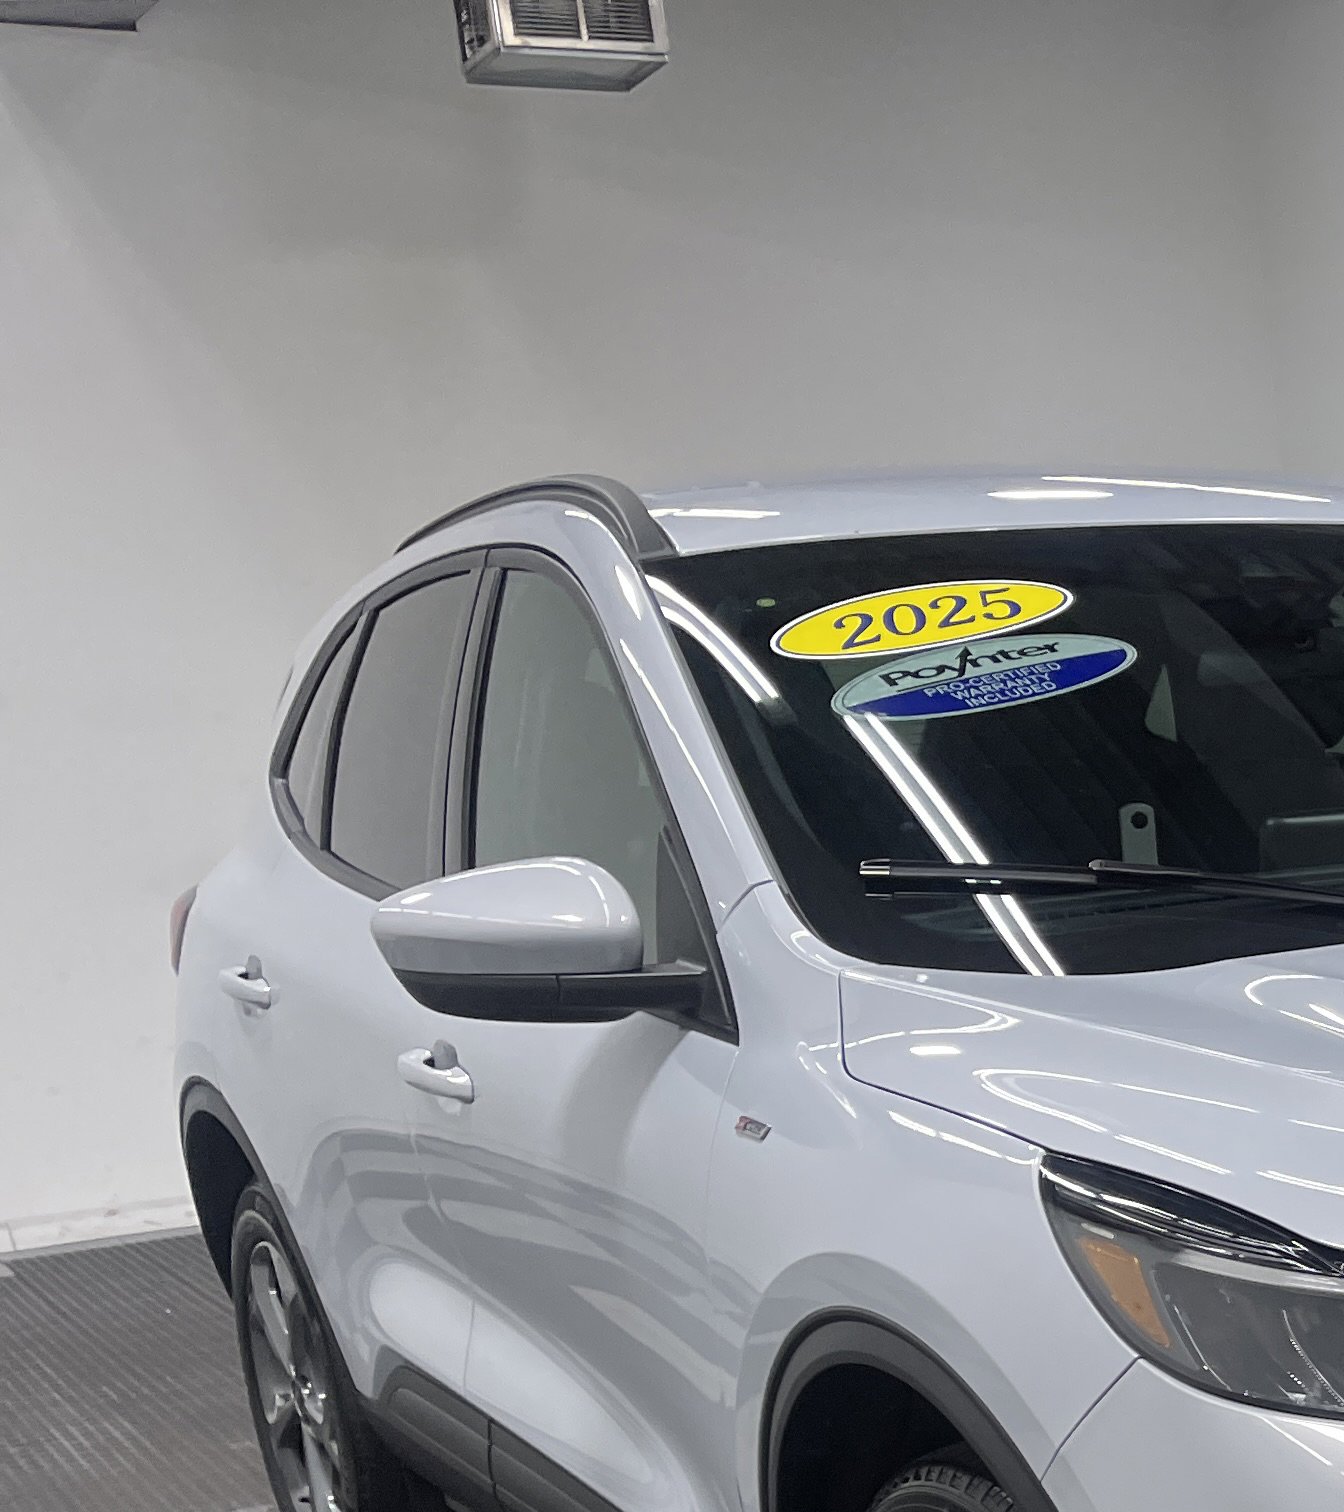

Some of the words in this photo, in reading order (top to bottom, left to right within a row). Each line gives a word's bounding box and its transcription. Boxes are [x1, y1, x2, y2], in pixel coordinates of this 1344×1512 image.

[833, 587, 1023, 651] 2025
[879, 642, 1060, 688] Poynter
[924, 662, 1061, 697] PRO-CERTIFIED
[950, 672, 1051, 701] WARRANTY
[965, 681, 1057, 708] INCLUDED
